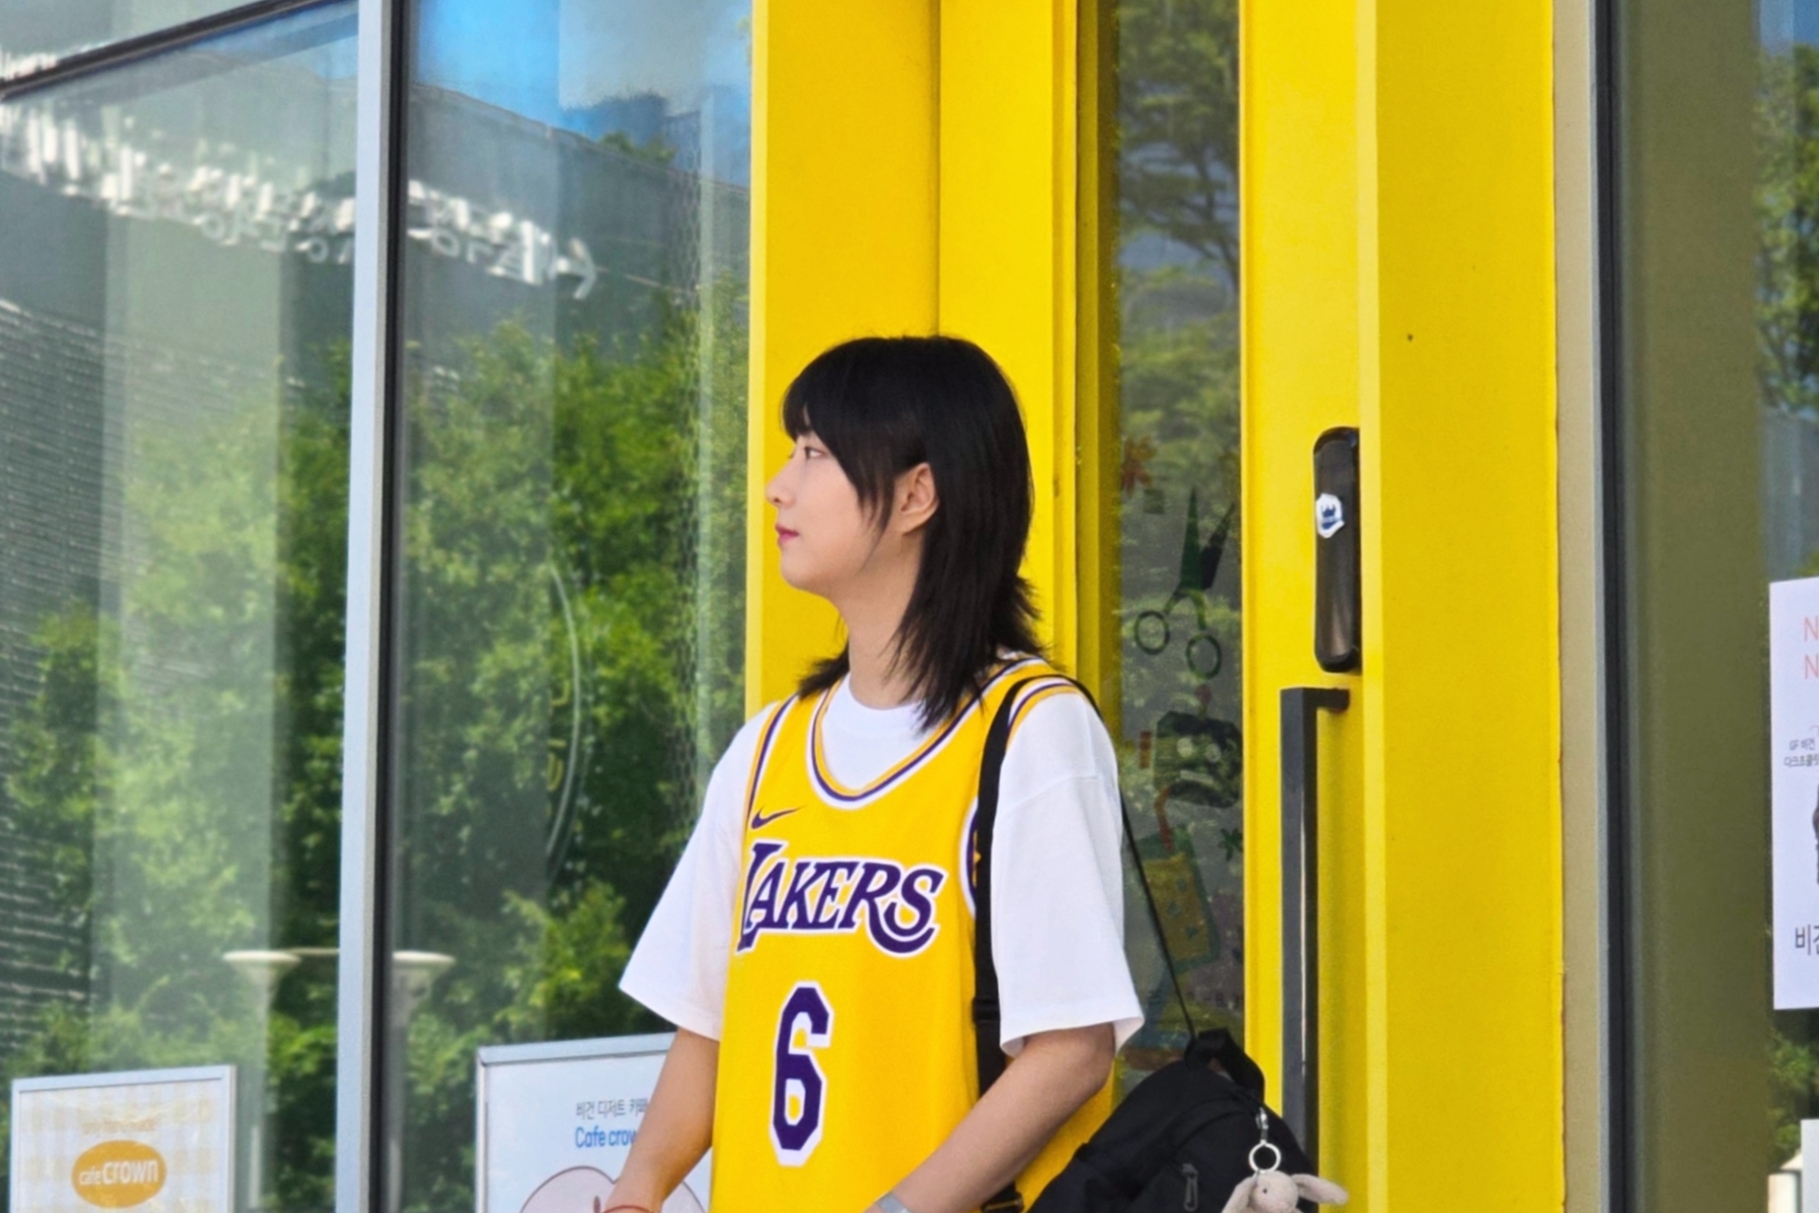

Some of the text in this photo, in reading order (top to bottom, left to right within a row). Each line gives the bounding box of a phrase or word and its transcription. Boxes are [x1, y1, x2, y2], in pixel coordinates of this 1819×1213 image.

[735, 838, 949, 959] LAKERS
[769, 980, 834, 1167] 6
[575, 1101, 596, 1120] 비건
[597, 1099, 626, 1119] 디저트
[575, 1125, 606, 1149] Cafe
[102, 1158, 159, 1185] crown
